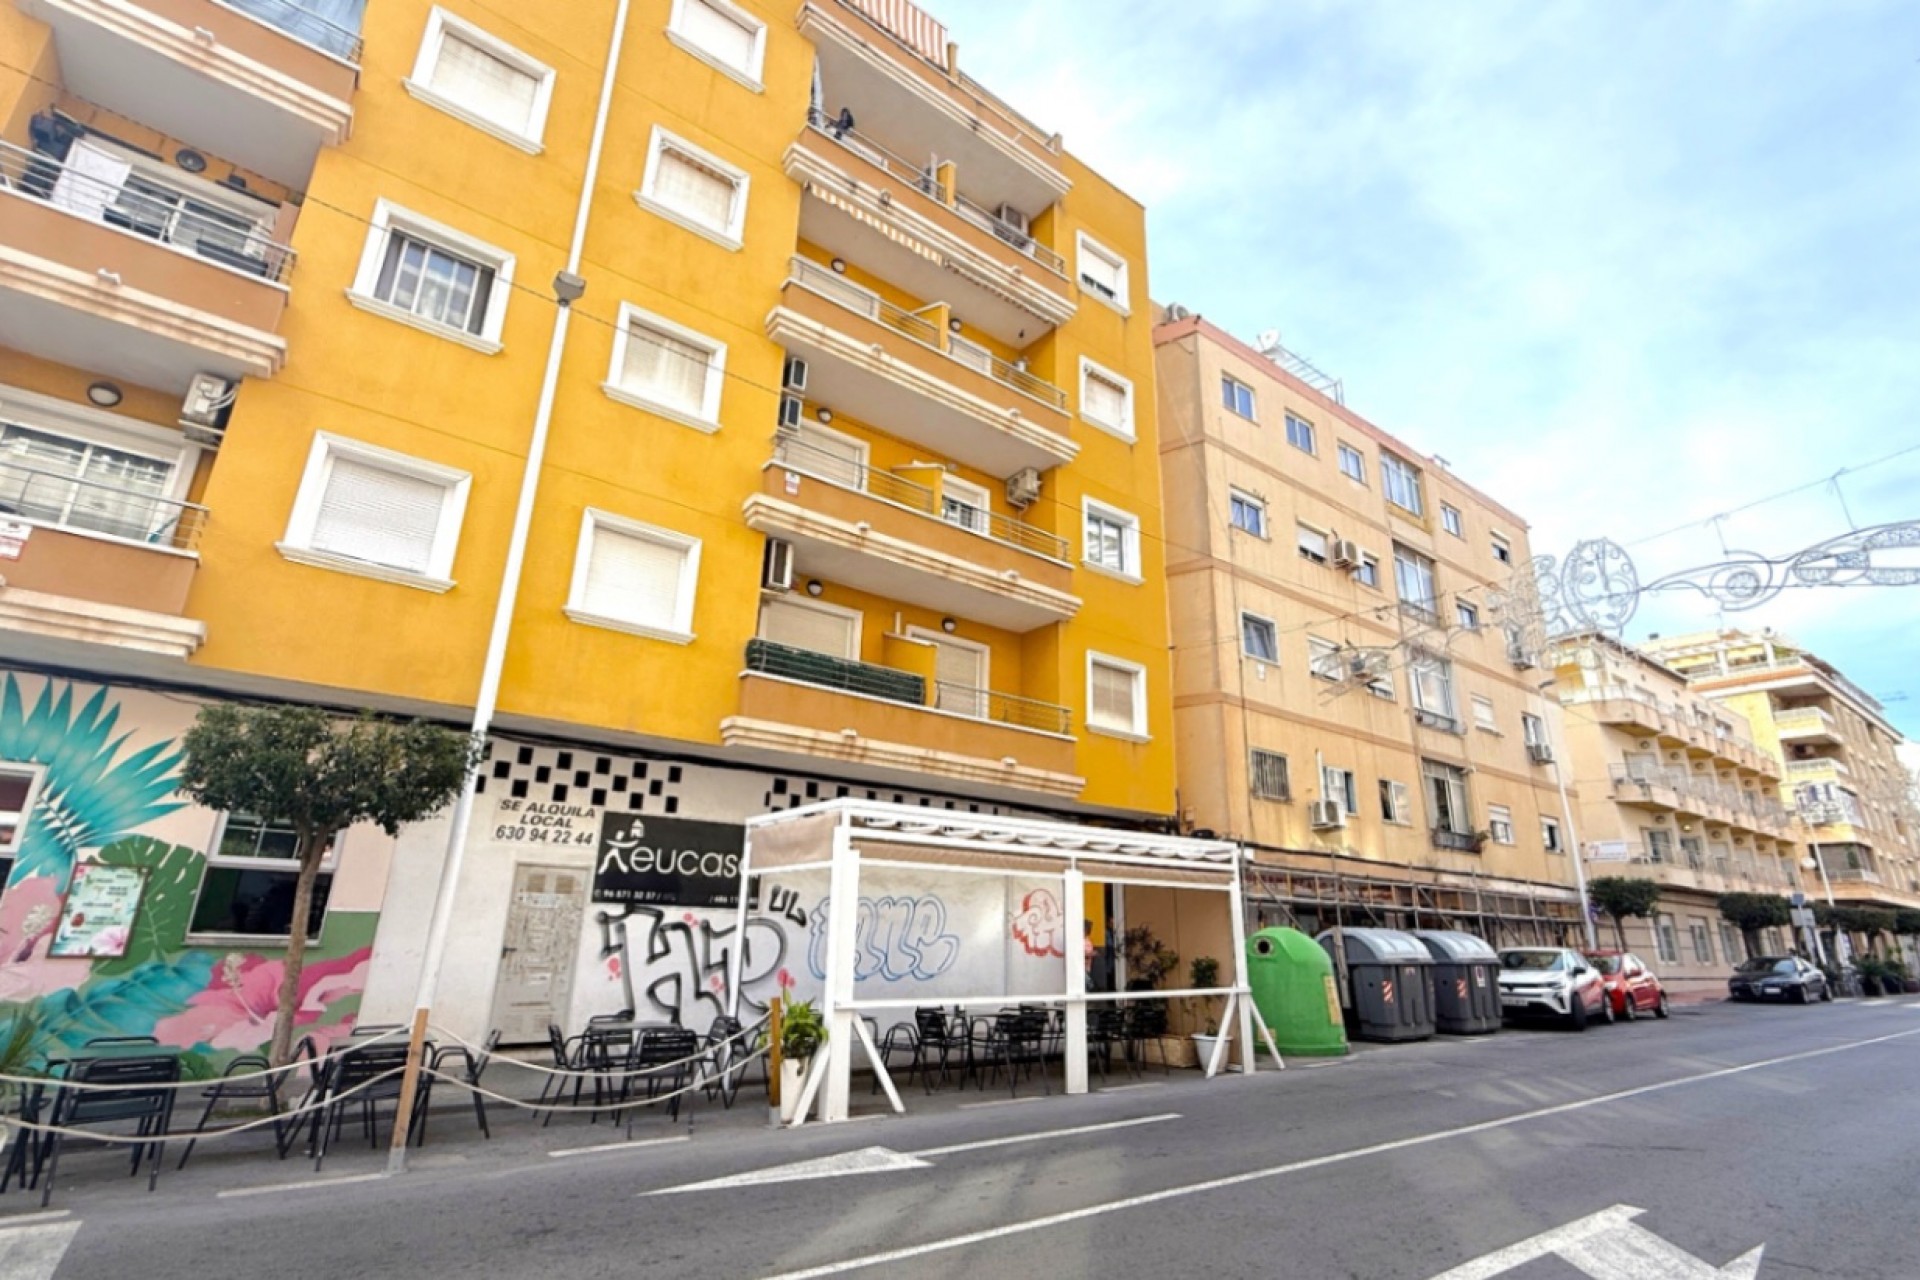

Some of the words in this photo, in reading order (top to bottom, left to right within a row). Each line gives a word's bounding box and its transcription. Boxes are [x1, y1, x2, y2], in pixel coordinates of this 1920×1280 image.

[500, 799, 522, 811] SE
[526, 802, 595, 818] ALQUILA
[520, 814, 573, 828] LOCAL
[496, 825, 525, 840] 630
[529, 828, 548, 841] 94
[553, 830, 571, 844] 22
[575, 832, 594, 846] 44
